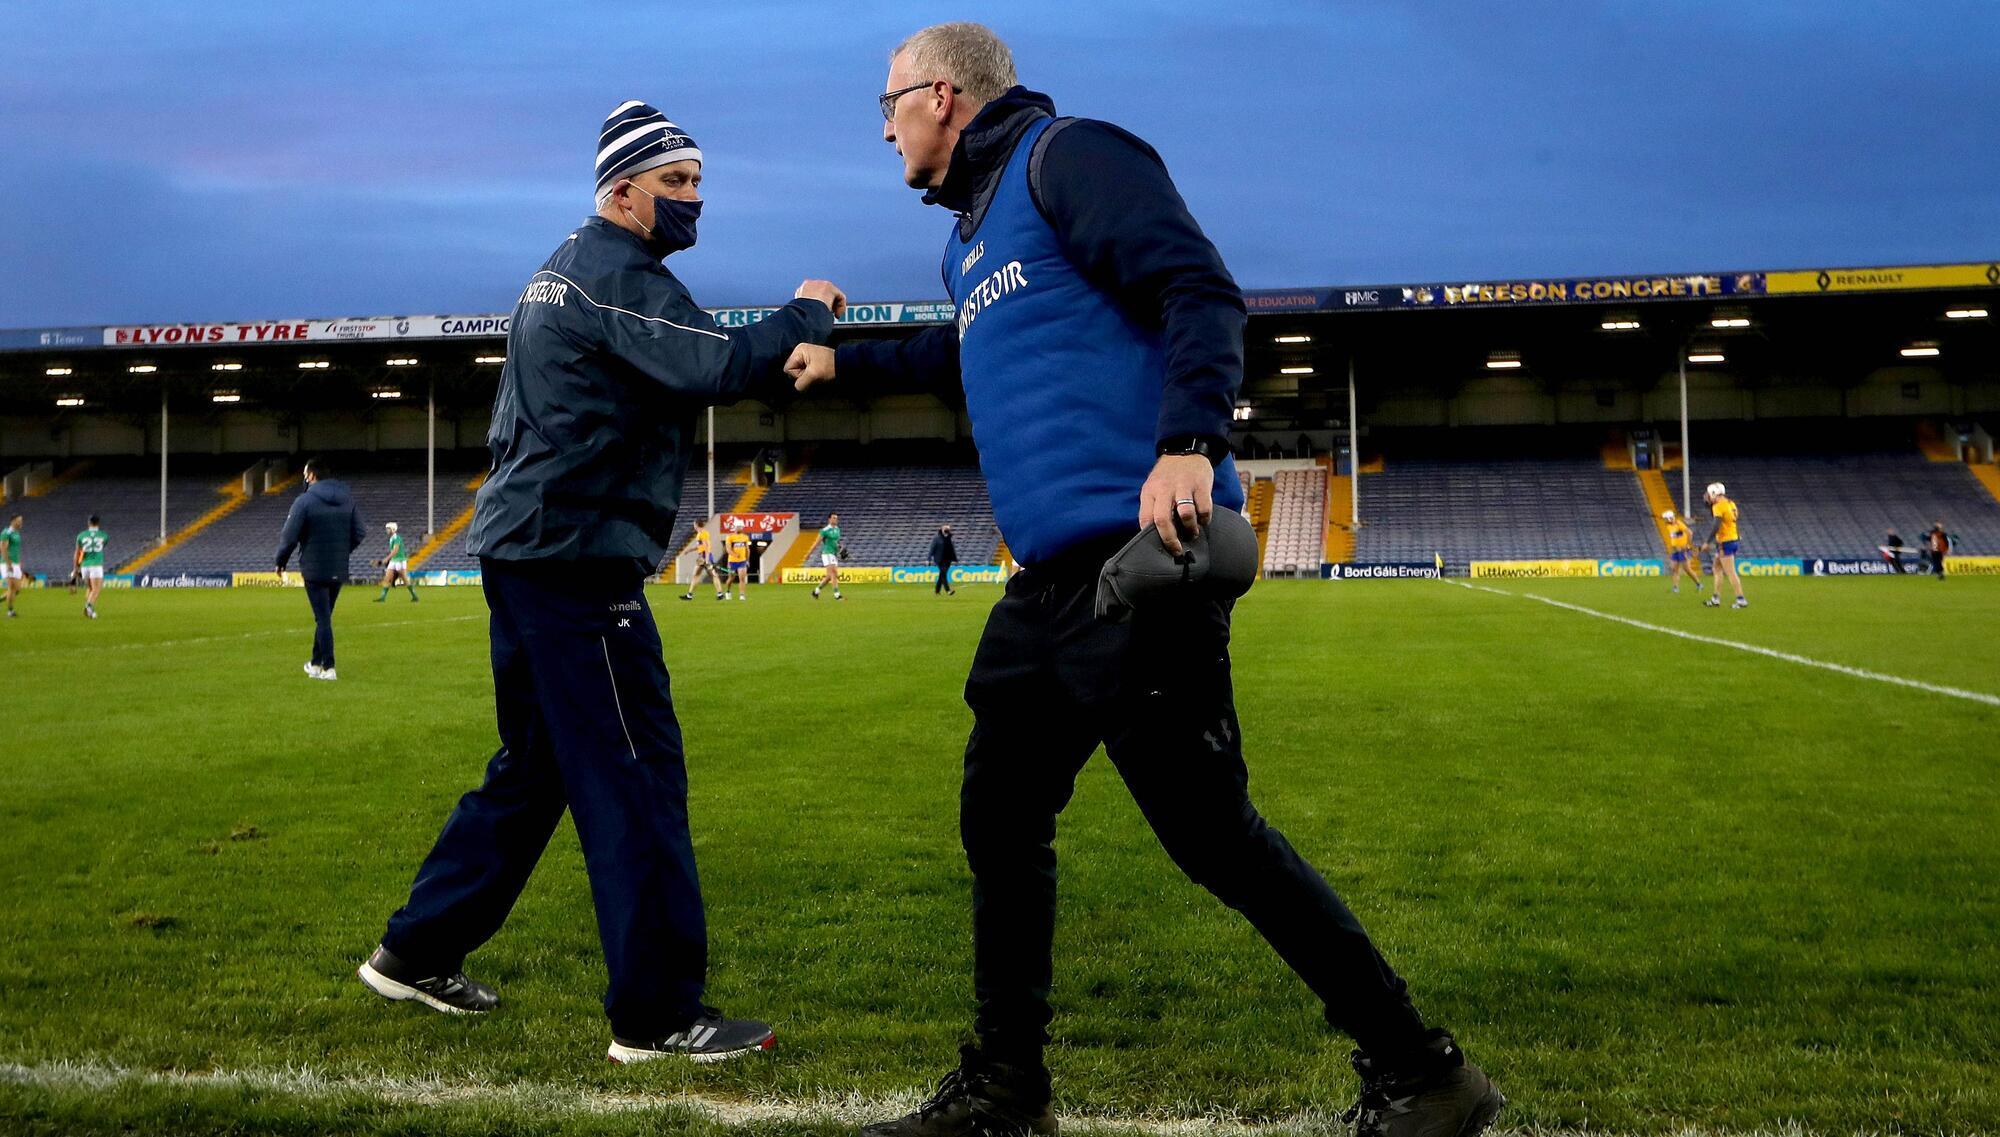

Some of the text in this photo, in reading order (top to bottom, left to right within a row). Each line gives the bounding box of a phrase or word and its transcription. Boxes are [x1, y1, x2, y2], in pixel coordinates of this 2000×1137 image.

[1837, 274, 1903, 285] RENAULT
[1575, 277, 1721, 299] CONCRETE
[1259, 295, 1316, 307] EDUCATION
[1357, 291, 1379, 301] MIC
[914, 312, 938, 320] MORE
[132, 323, 309, 344] LYONS TYRE
[82, 537, 104, 552] 23
[1344, 567, 1371, 577] Bord
[1399, 567, 1437, 579] Energy
[1477, 562, 1593, 578] Littlewoods Ireland
[1601, 562, 1660, 576] Centra
[1738, 563, 1799, 576] Centra
[1829, 562, 1857, 574] Bord
[152, 576, 174, 588] Bord
[196, 577, 228, 588] Energy
[618, 618, 630, 627] JK
